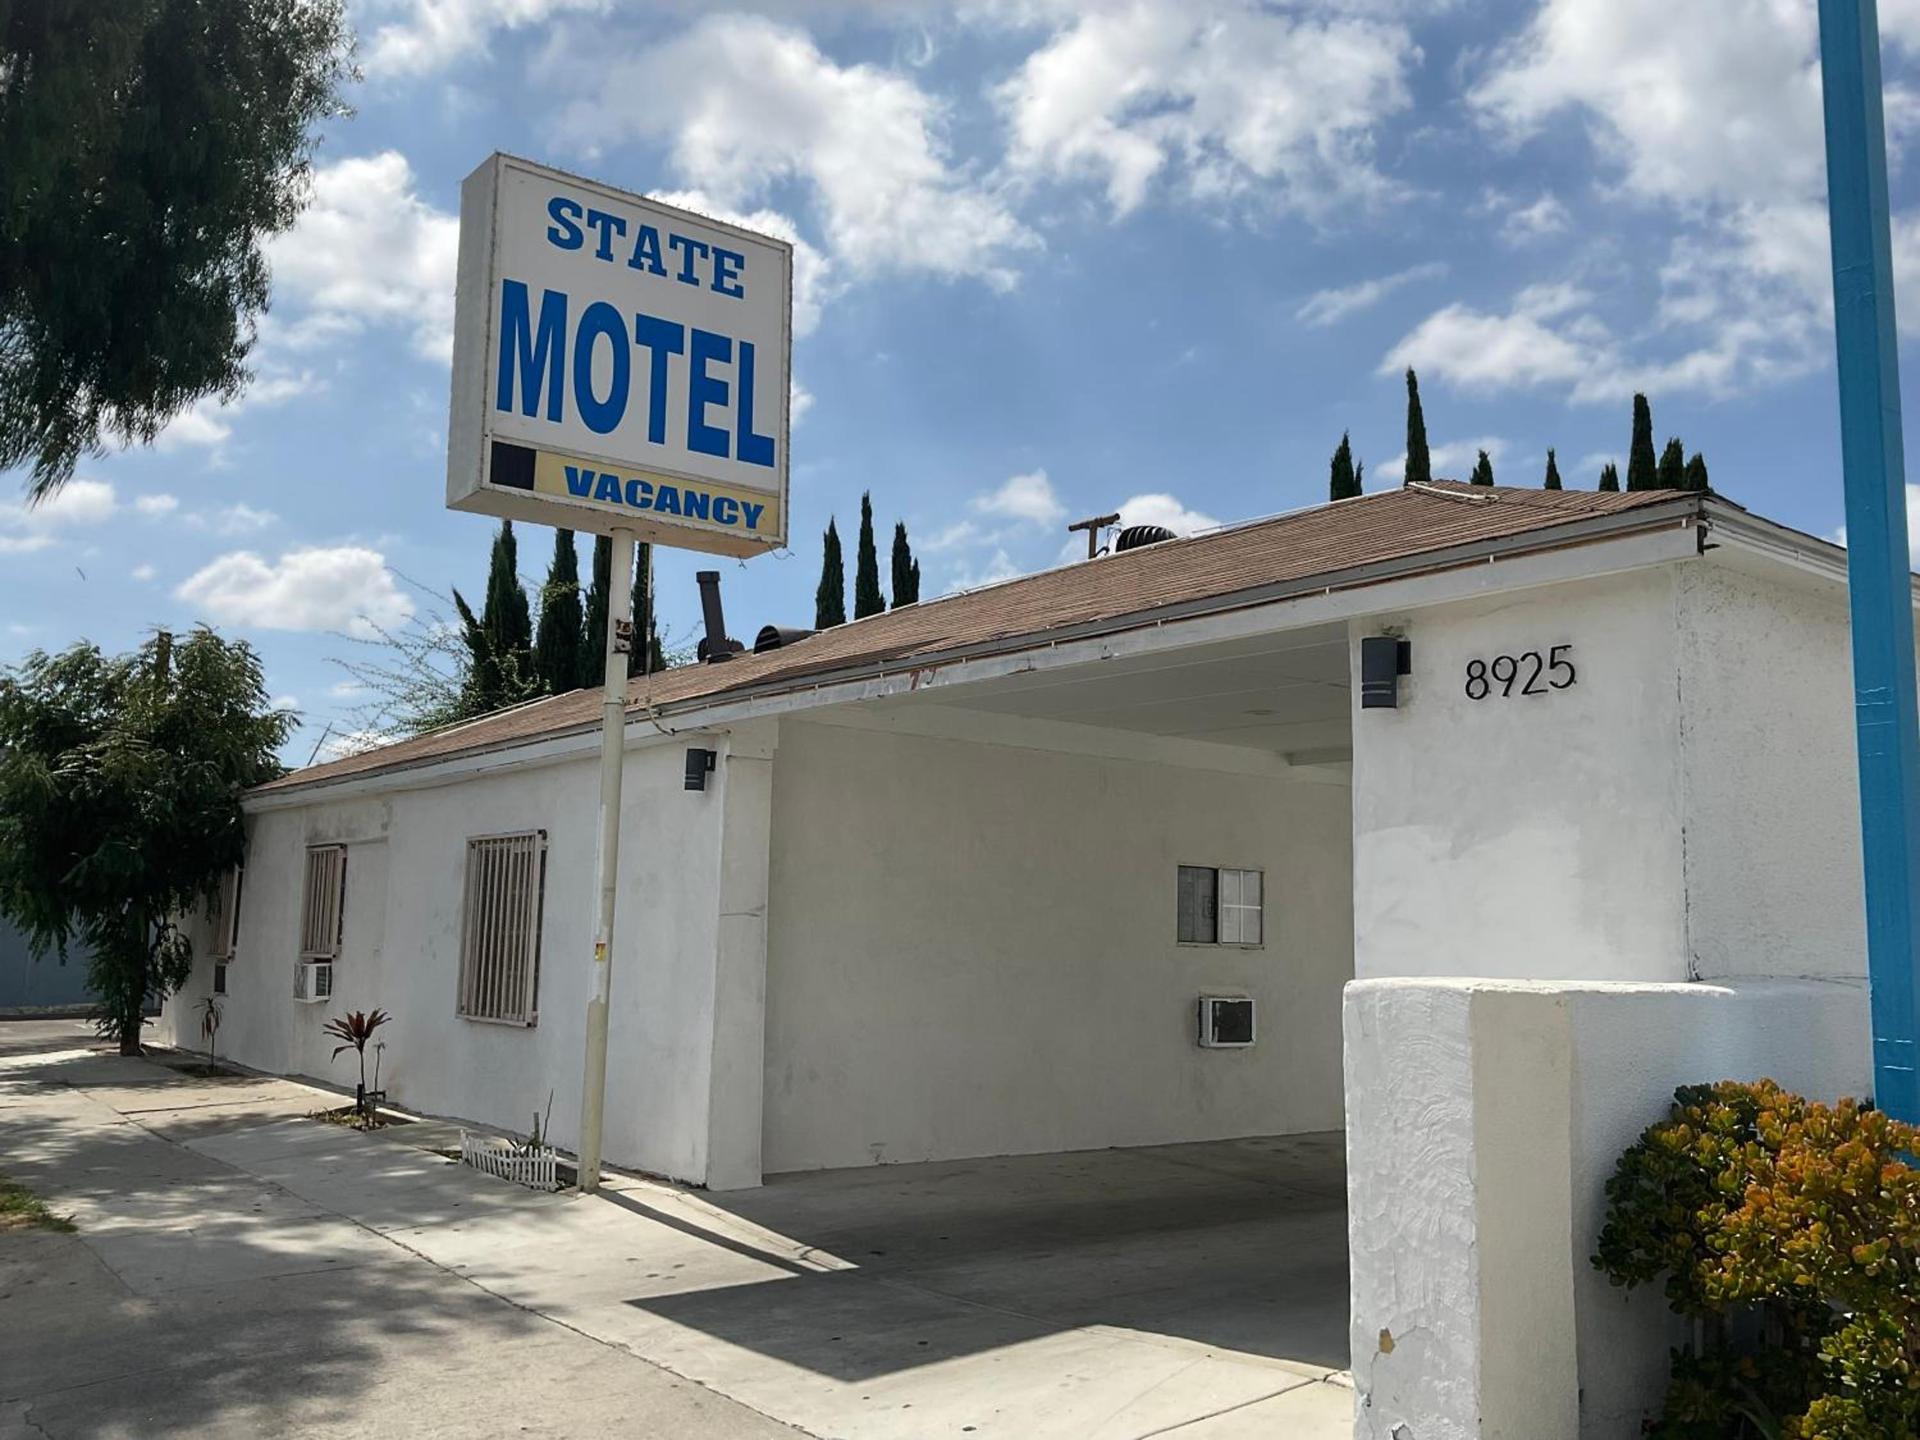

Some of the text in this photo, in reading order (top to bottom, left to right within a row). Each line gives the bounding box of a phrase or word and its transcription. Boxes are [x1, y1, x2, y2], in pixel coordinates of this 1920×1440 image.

[547, 197, 745, 299] STATE
[497, 278, 775, 468] MOTEL
[564, 466, 764, 529] VACANCY
[1465, 645, 1577, 700] 8925
